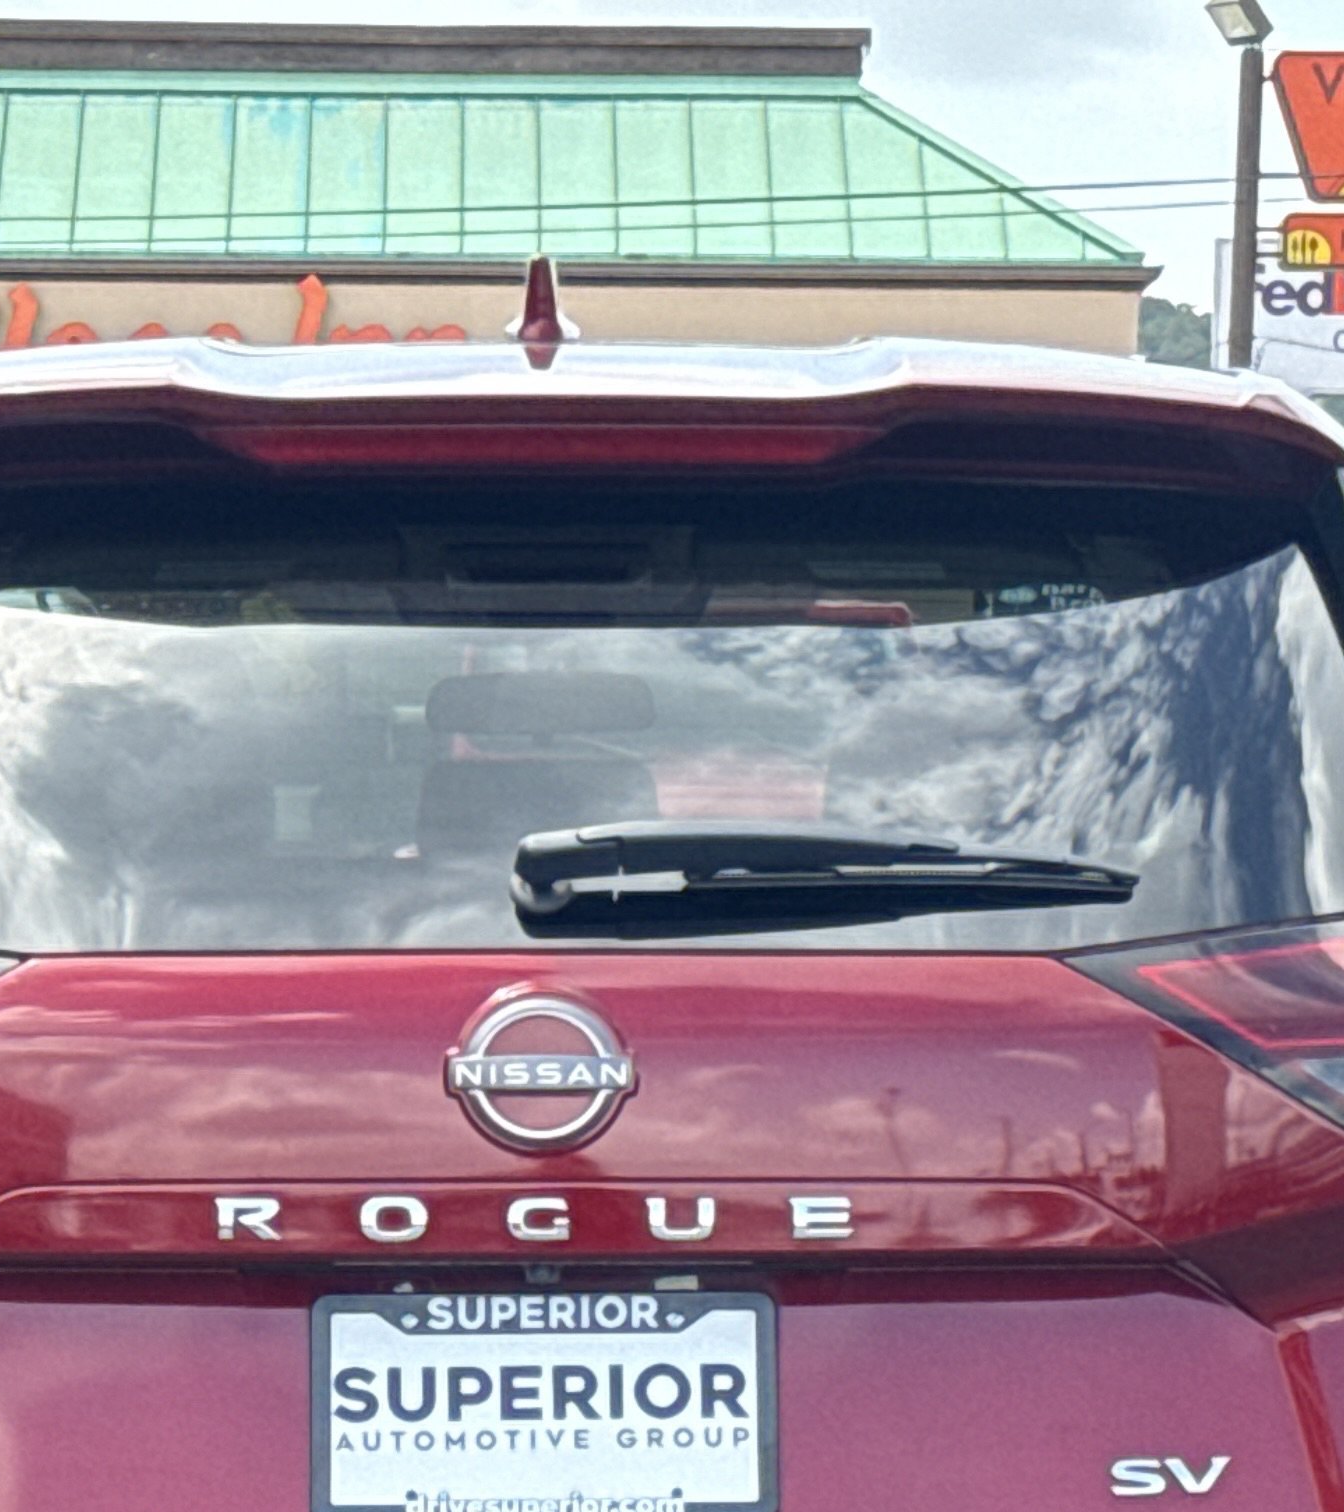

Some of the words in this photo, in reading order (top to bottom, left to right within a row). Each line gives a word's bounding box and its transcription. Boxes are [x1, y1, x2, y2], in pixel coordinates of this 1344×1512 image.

[455, 1061, 630, 1087] NISSAN
[214, 1196, 855, 1242] ROGUE
[426, 1294, 659, 1331] SUPERIOR
[333, 1363, 750, 1423] SUPERIOR
[336, 1429, 591, 1452] AUTOMOTIVE
[616, 1427, 751, 1449] GROUP
[1110, 1456, 1232, 1496] SV
